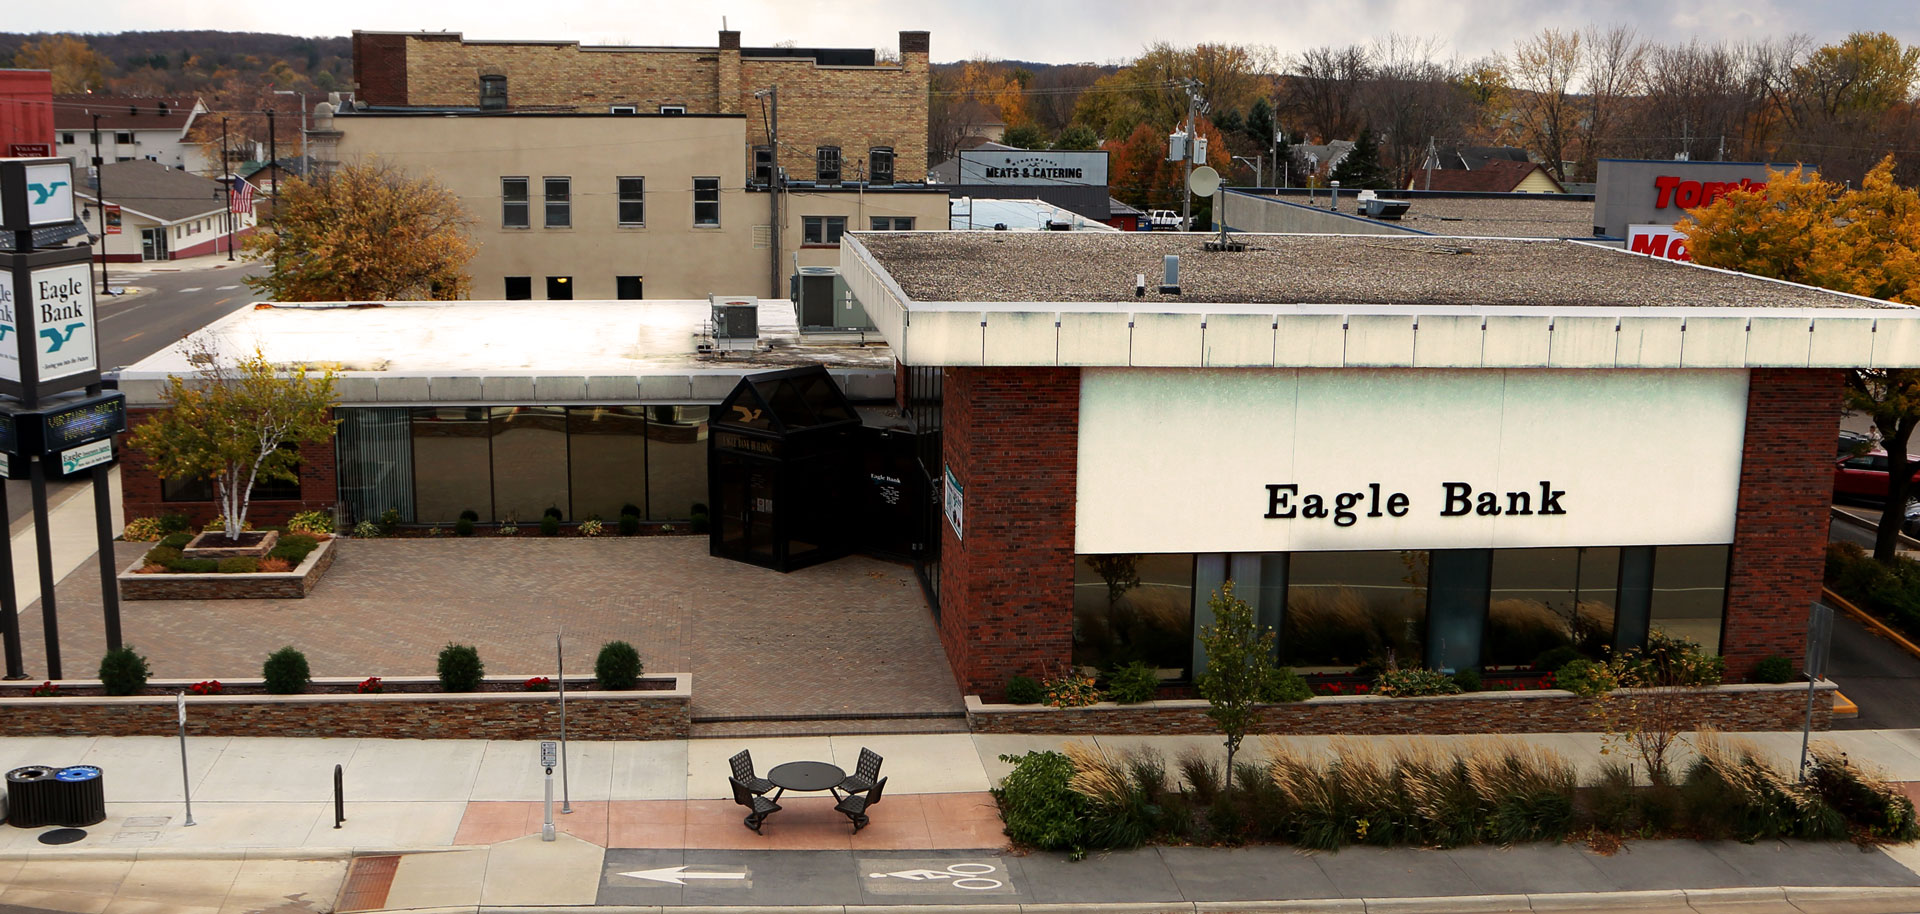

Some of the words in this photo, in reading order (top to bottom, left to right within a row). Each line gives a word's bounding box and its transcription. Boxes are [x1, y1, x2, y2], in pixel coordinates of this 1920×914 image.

[986, 167, 1019, 178] MEATS
[1022, 167, 1030, 178] &
[1033, 167, 1082, 178] CATERING
[38, 277, 82, 303] Eagle
[40, 301, 83, 324] Bank
[62, 451, 82, 463] Eagle
[870, 473, 885, 481] Eagle
[1263, 483, 1410, 527] Eagle
[1440, 481, 1567, 516] Bank
